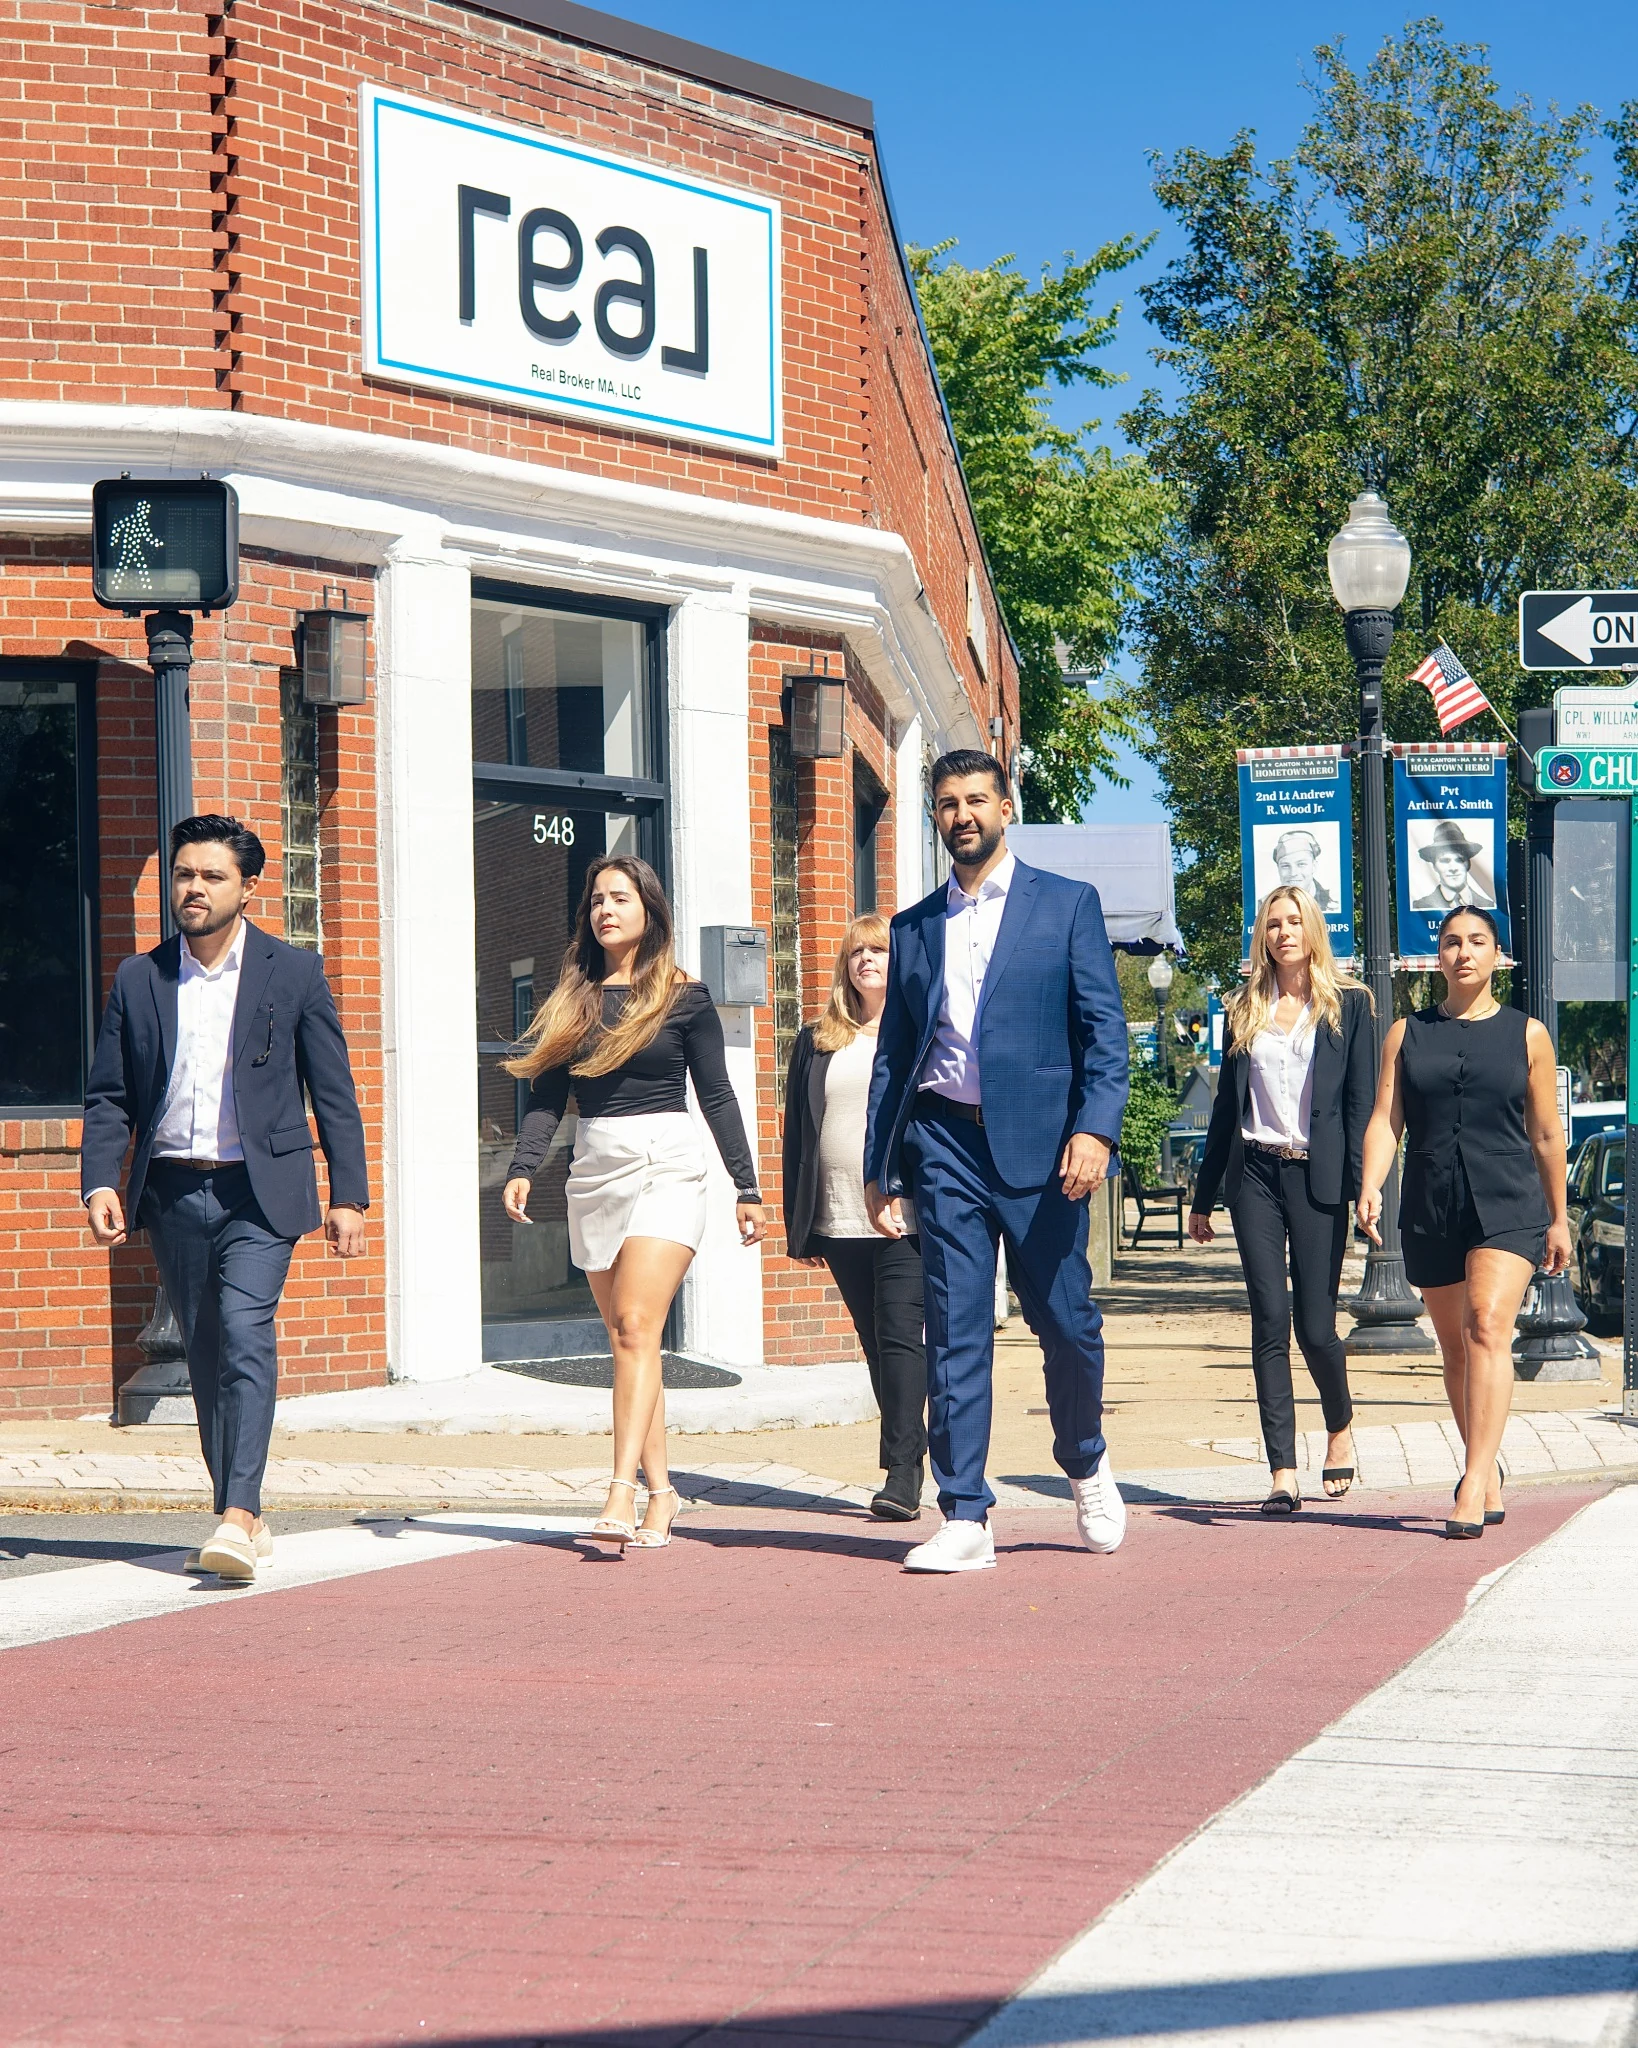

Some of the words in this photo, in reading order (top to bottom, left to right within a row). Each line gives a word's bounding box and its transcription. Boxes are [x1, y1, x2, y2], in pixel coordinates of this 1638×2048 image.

[531, 364, 555, 382] Real
[559, 370, 595, 390] Broker
[598, 378, 618, 397] MA,
[621, 383, 641, 400] LLC
[1565, 711, 1590, 725] CPL.
[1593, 711, 1638, 725] WILLIAM
[1255, 768, 1308, 777] HOMETOWN
[1309, 766, 1334, 775] HERO
[1410, 763, 1463, 772] HOMETOWN
[1464, 763, 1490, 771] HERO
[1256, 791, 1277, 801] 2nd
[1279, 791, 1290, 801] Lt
[1291, 789, 1335, 800] Andrew
[1440, 786, 1459, 796] Pvt
[1266, 805, 1278, 815] R.
[1279, 803, 1312, 815] Wood
[1313, 803, 1325, 815] Jr.
[1408, 800, 1444, 810] Arthur
[1446, 800, 1458, 810] A.
[1459, 798, 1494, 810] Smith
[533, 814, 575, 846] 548
